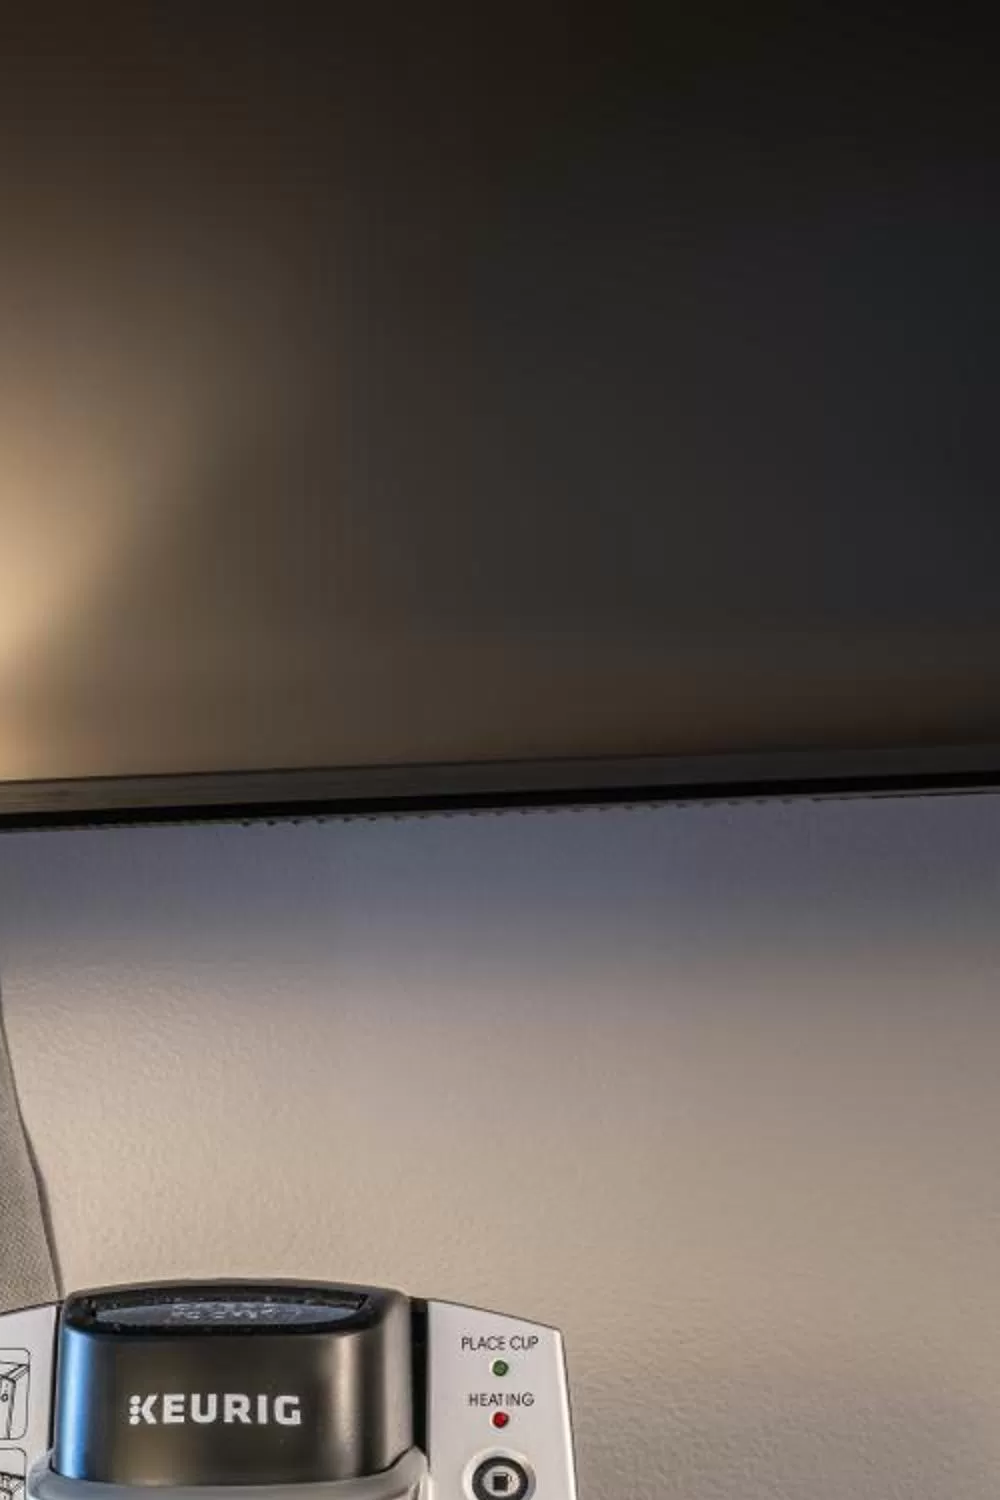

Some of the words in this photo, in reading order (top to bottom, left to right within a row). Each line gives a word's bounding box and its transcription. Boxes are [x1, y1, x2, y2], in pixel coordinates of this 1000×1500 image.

[460, 1336, 506, 1351] PLACE
[509, 1336, 539, 1351] CUP
[468, 1392, 535, 1407] HEATING
[129, 1394, 301, 1426] KEURIG
